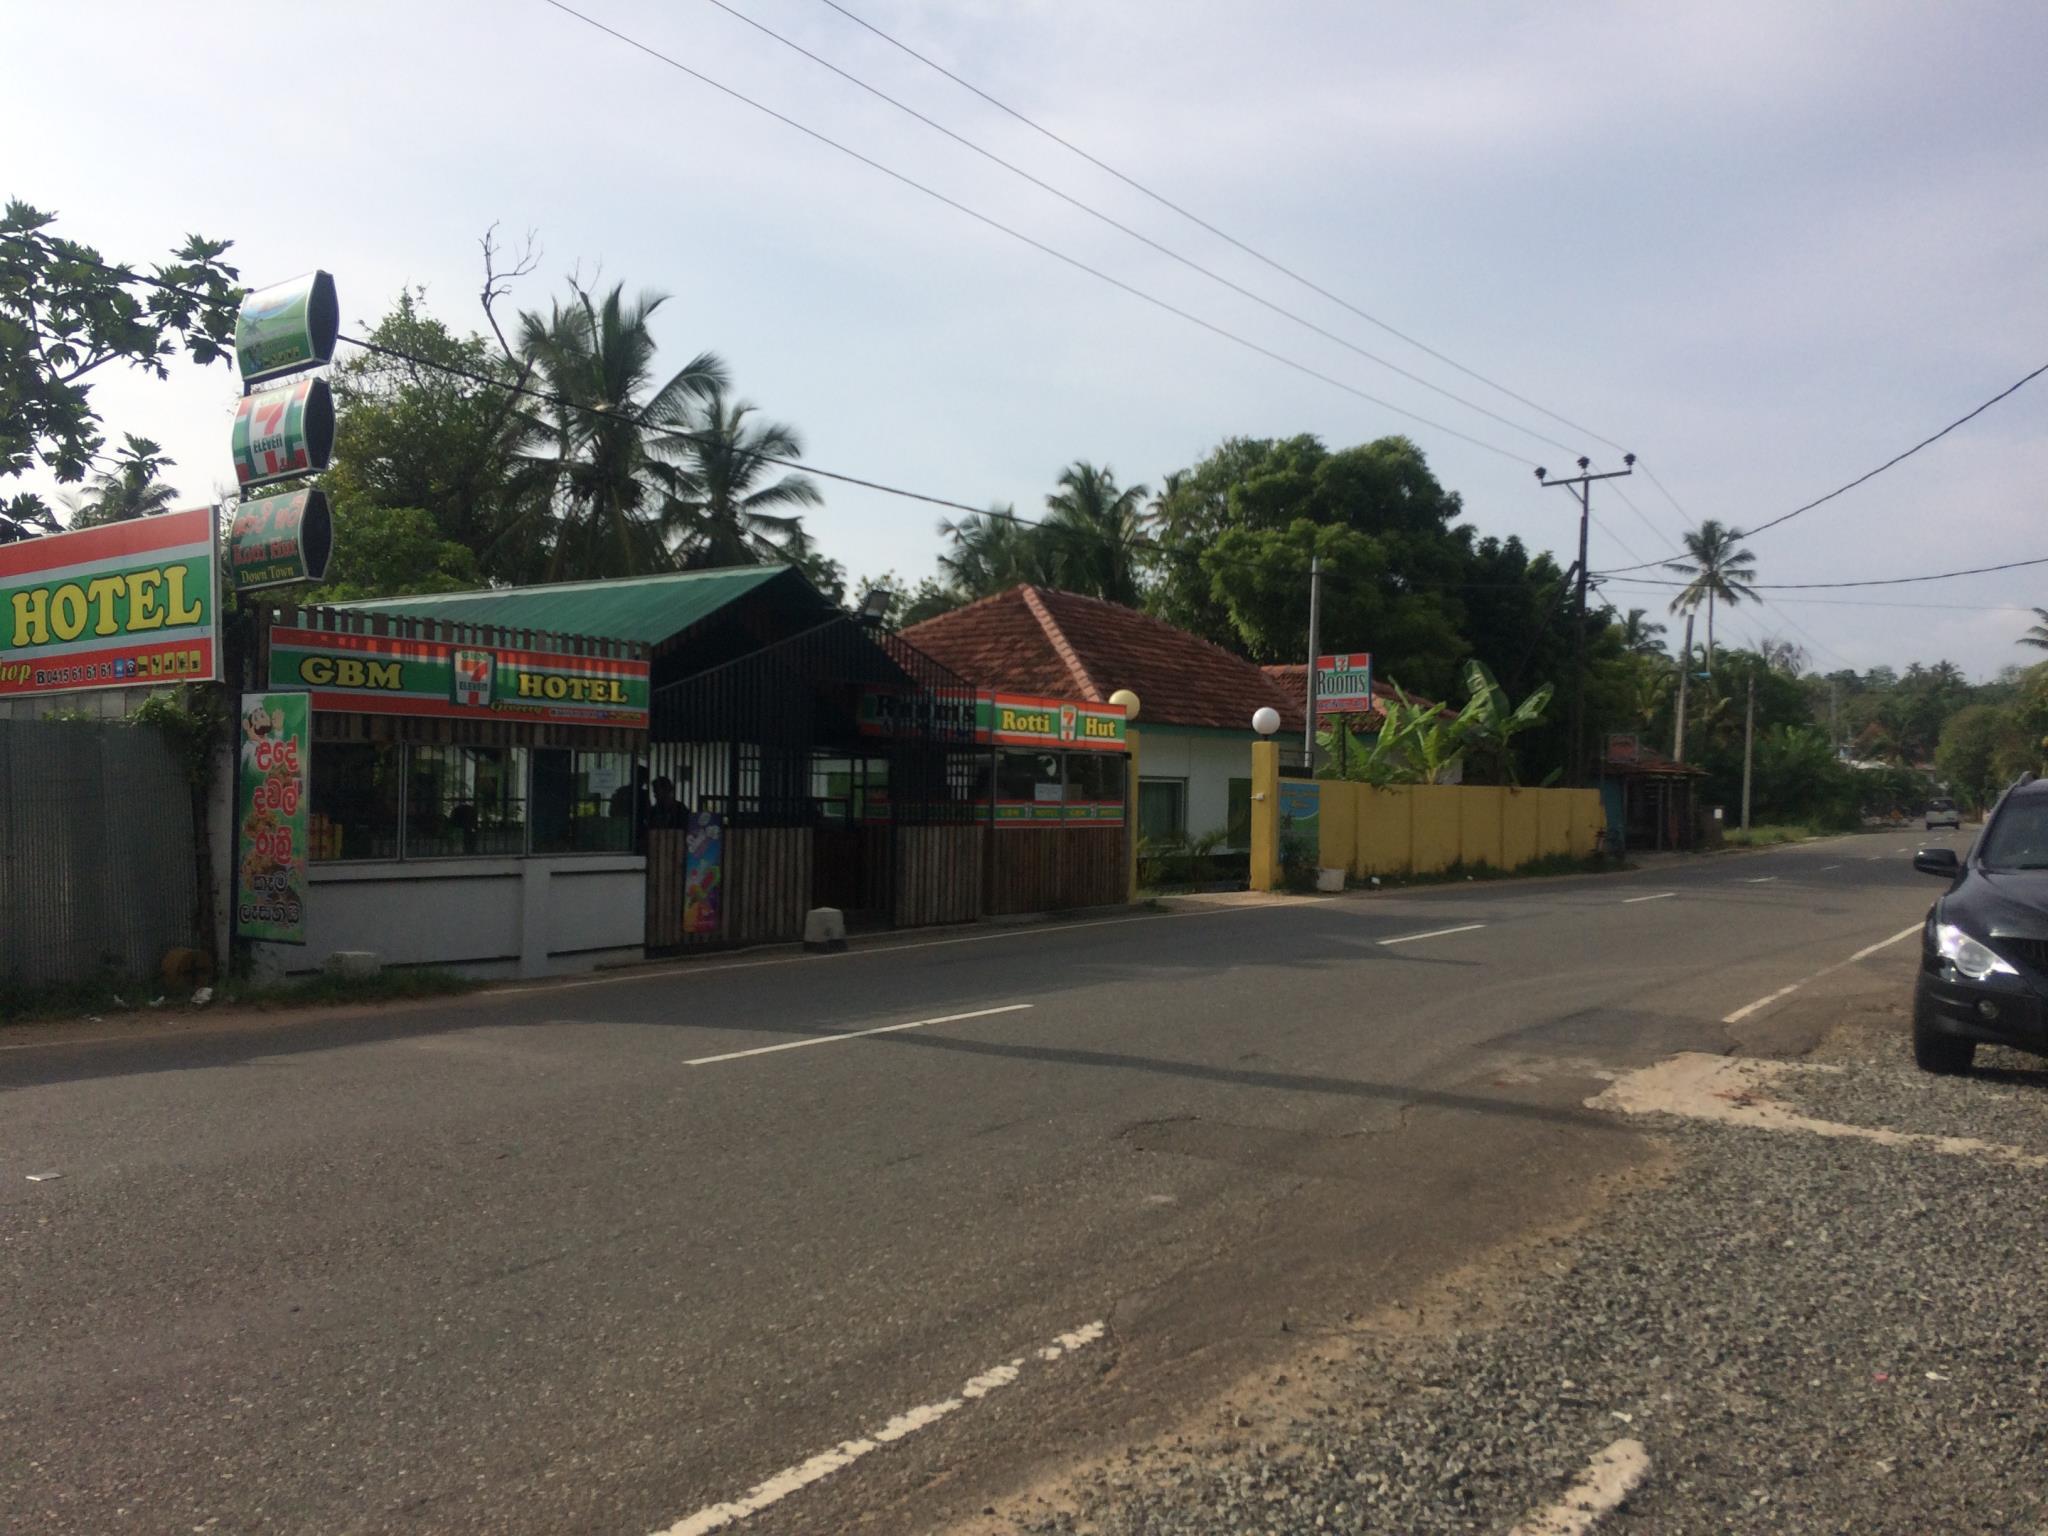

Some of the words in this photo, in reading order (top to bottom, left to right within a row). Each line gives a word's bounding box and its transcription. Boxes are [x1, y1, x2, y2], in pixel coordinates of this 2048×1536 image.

[240, 569, 267, 584] Down
[268, 565, 295, 578] Town
[11, 565, 202, 648] HOTEL
[300, 656, 404, 691] GBM
[1317, 670, 1366, 695] Rooms
[518, 673, 629, 704] HOTEL
[1002, 710, 1051, 733] Rotti
[1085, 717, 1116, 737] Hut
